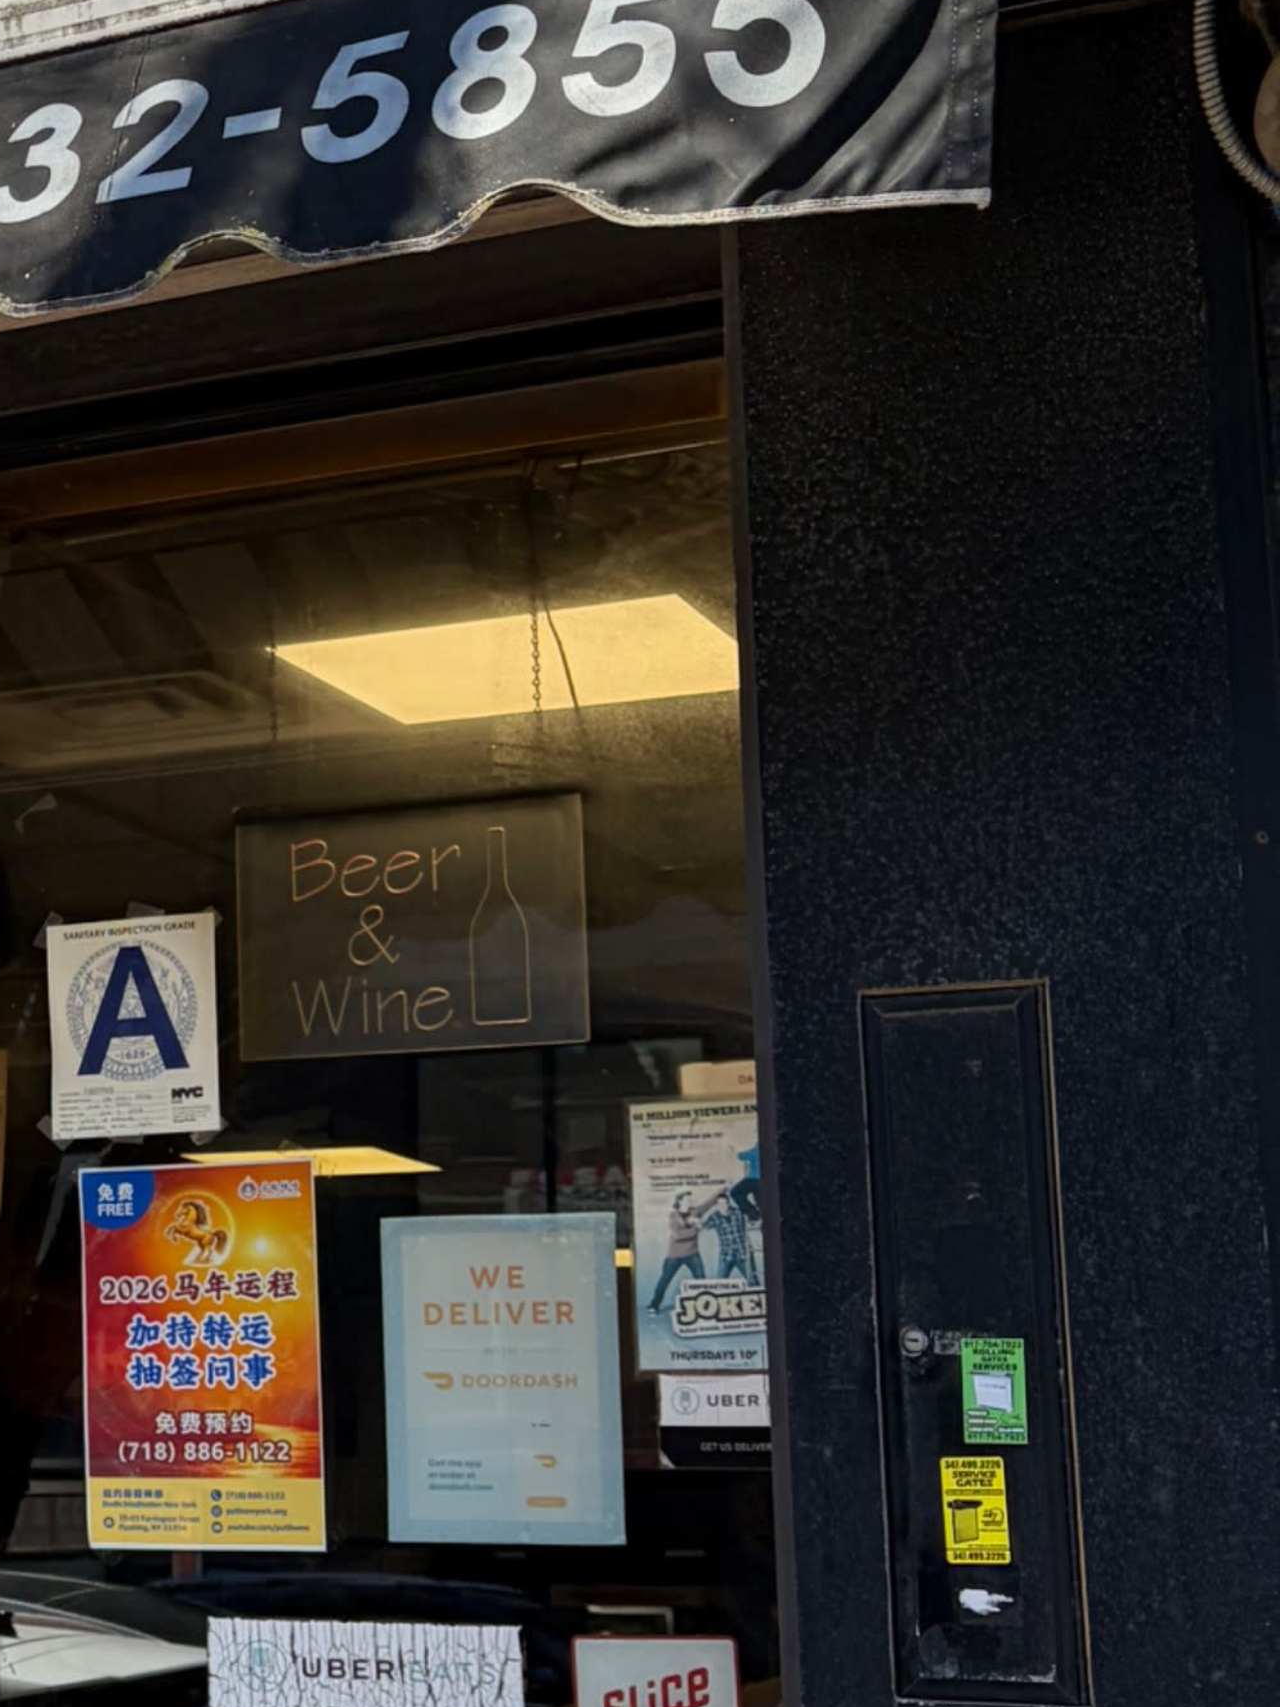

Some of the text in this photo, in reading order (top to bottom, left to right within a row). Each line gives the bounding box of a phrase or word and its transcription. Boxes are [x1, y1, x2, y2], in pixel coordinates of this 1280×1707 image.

[289, 837, 461, 902] Beer
[63, 920, 197, 941] SANITARY INSPECTION GRADE
[347, 903, 401, 967] &
[77, 945, 190, 1076] A
[291, 975, 454, 1036] Wine
[171, 1085, 204, 1100] NYC
[646, 1108, 692, 1121] MILLION
[693, 1105, 742, 1118] VIEWERS
[97, 1203, 134, 1217] FREE
[100, 1269, 299, 1303] 2026 马年运程
[468, 1264, 525, 1290] WE
[423, 1300, 575, 1326] DELIVER
[677, 1291, 767, 1326] JOKE
[126, 1312, 276, 1348] 加持转运
[669, 1349, 736, 1361] THURSDAYS
[972, 1363, 1018, 1371] SERVICES
[126, 1351, 276, 1391] 抽签问事
[461, 1373, 579, 1390] DOORDASH
[706, 1393, 761, 1407] UBER
[155, 1411, 253, 1435] 免费预约
[119, 1441, 291, 1463] (718) 886-1122
[952, 1470, 997, 1479] SERVICE
[955, 1479, 994, 1487] GATES
[301, 1656, 497, 1684] UBER EATS
